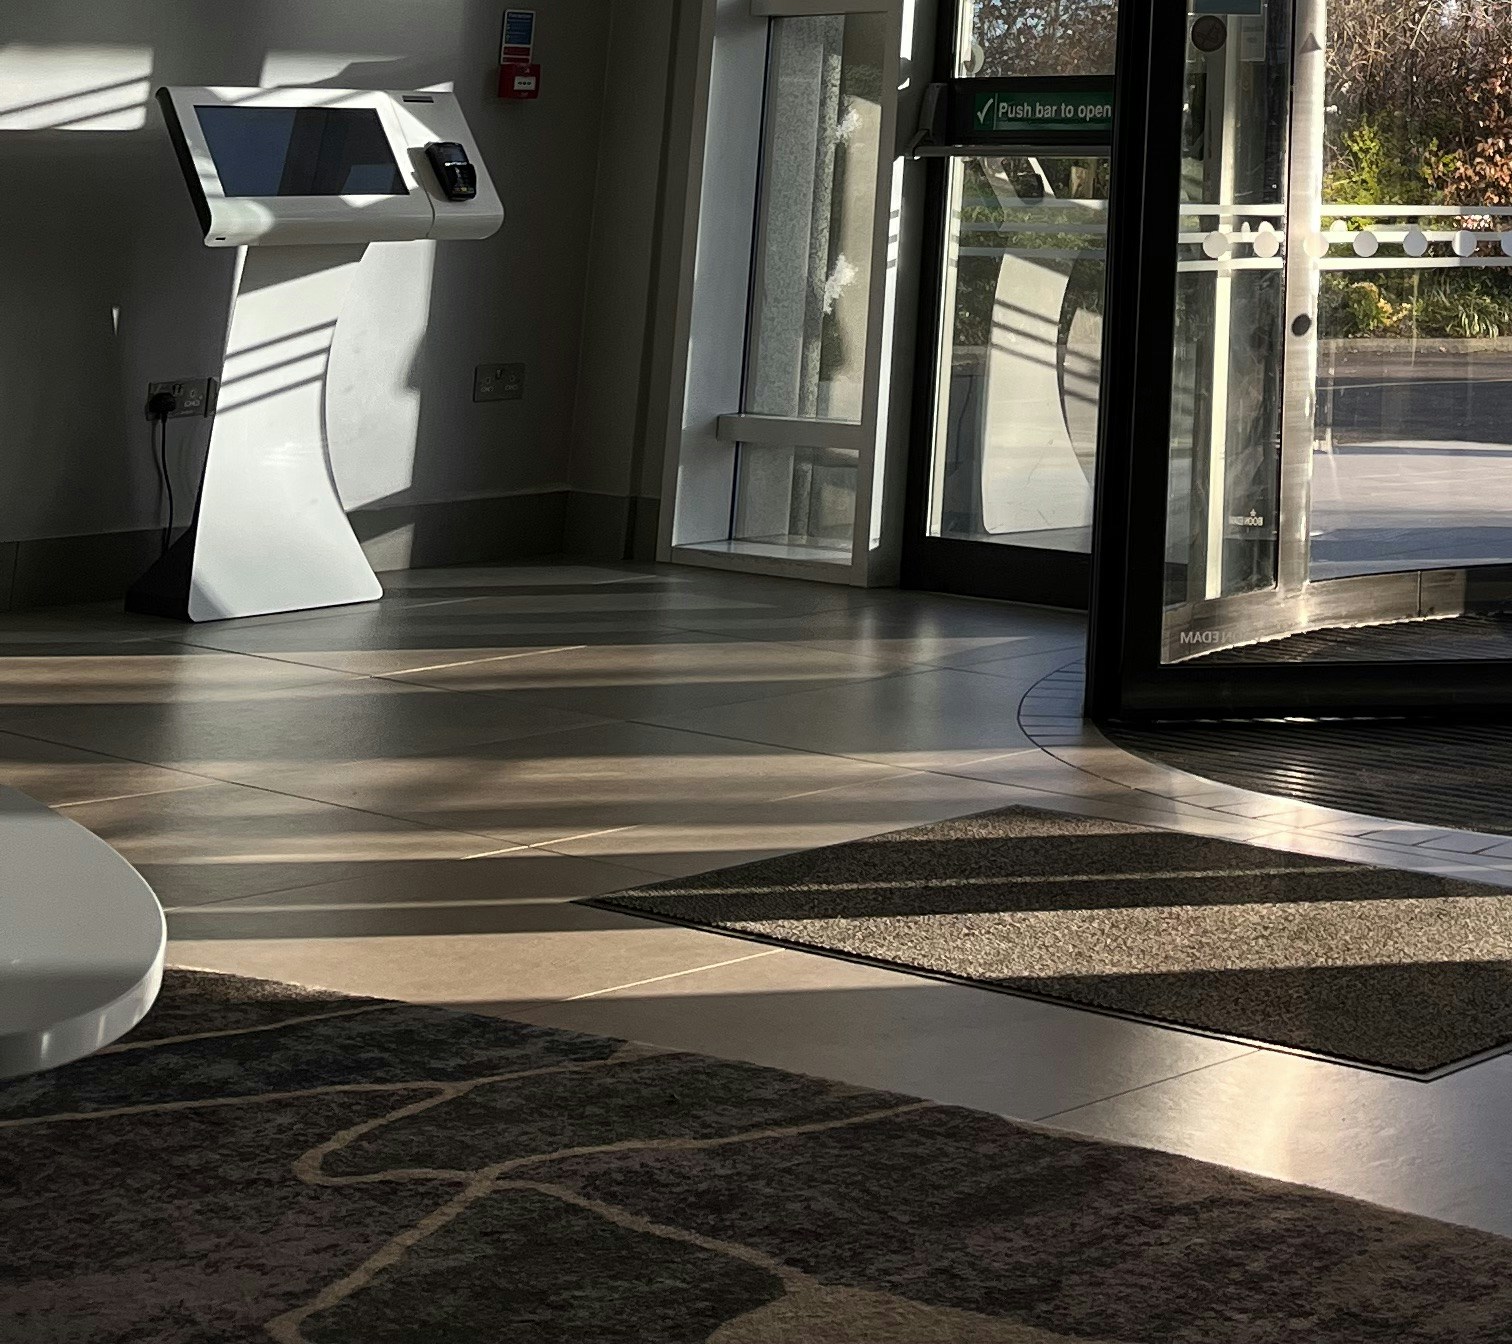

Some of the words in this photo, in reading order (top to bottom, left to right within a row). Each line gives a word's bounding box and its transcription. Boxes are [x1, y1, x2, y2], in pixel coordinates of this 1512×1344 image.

[998, 102, 1032, 118] Push
[1035, 102, 1058, 118] bar
[1061, 103, 1074, 118] to
[1077, 104, 1112, 121] open
